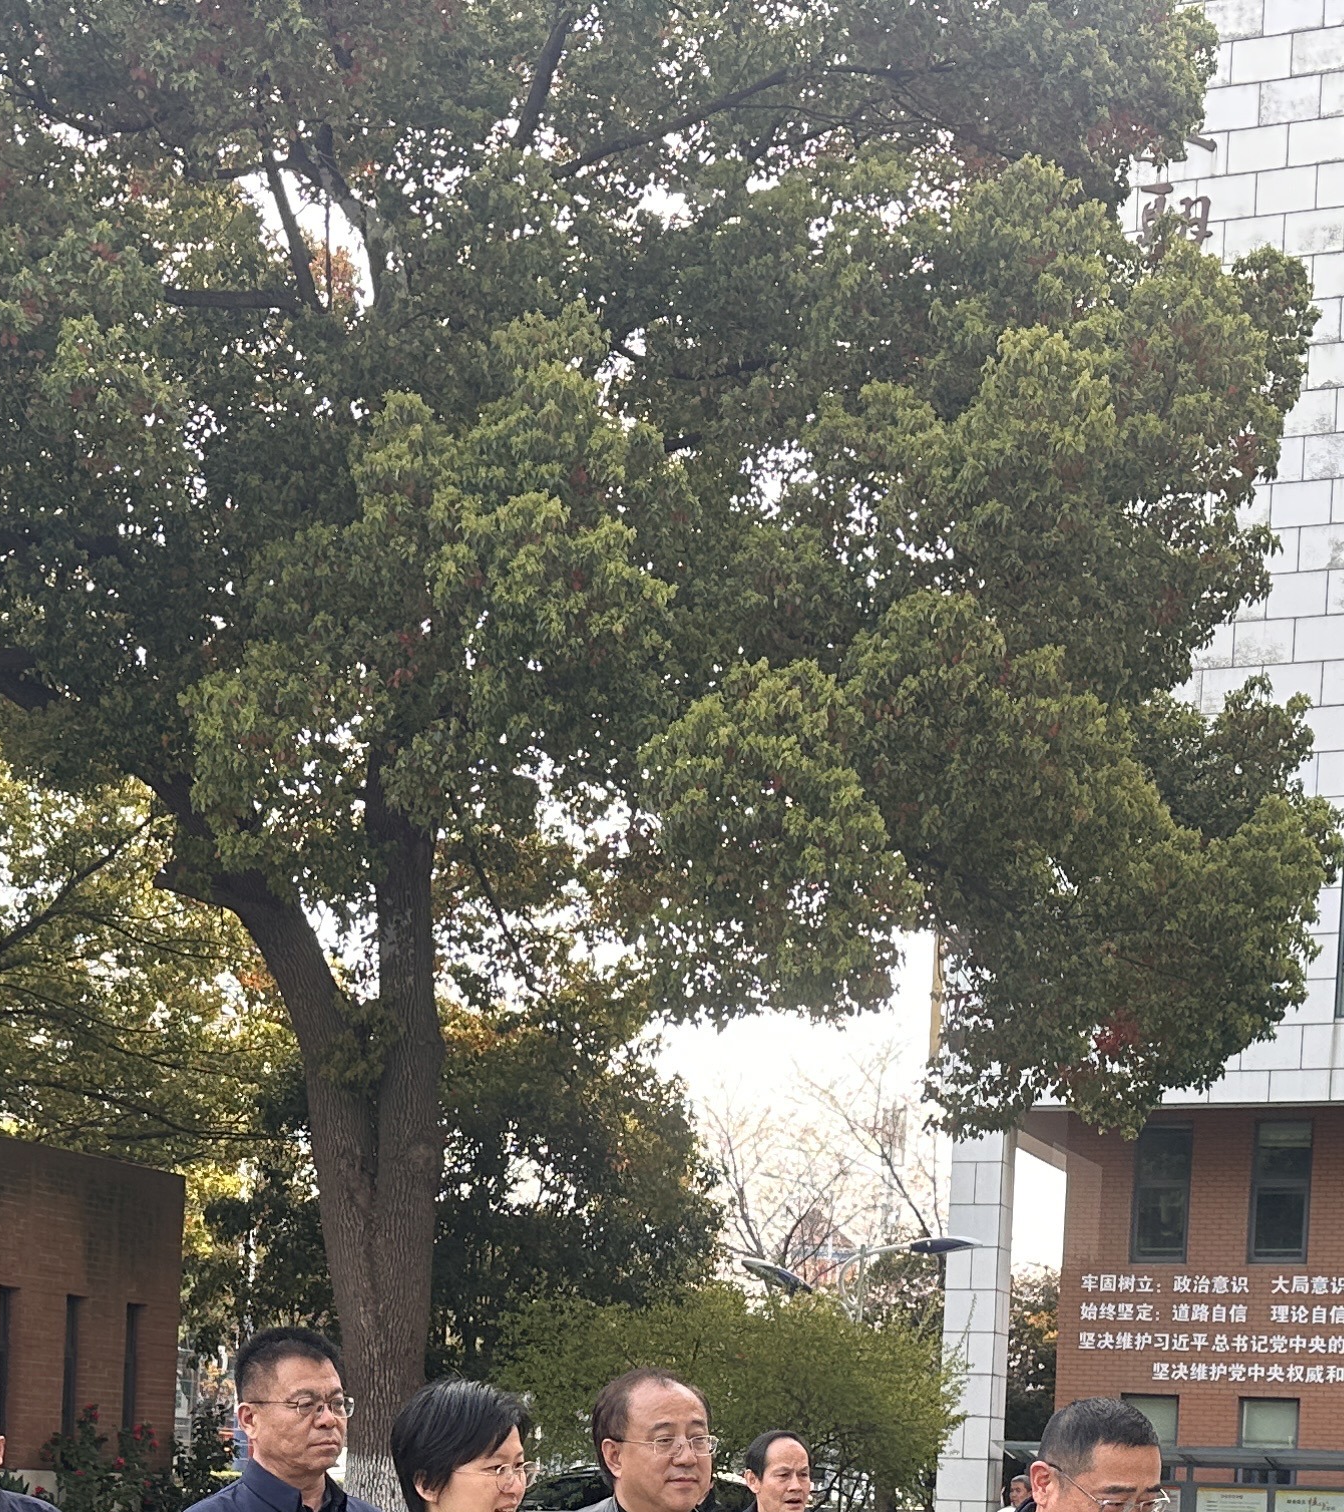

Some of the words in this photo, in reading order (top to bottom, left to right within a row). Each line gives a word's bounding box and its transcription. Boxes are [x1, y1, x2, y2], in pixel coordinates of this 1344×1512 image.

[1173, 1275, 1249, 1294] 政治意识
[1172, 1304, 1248, 1323] 道路自信
